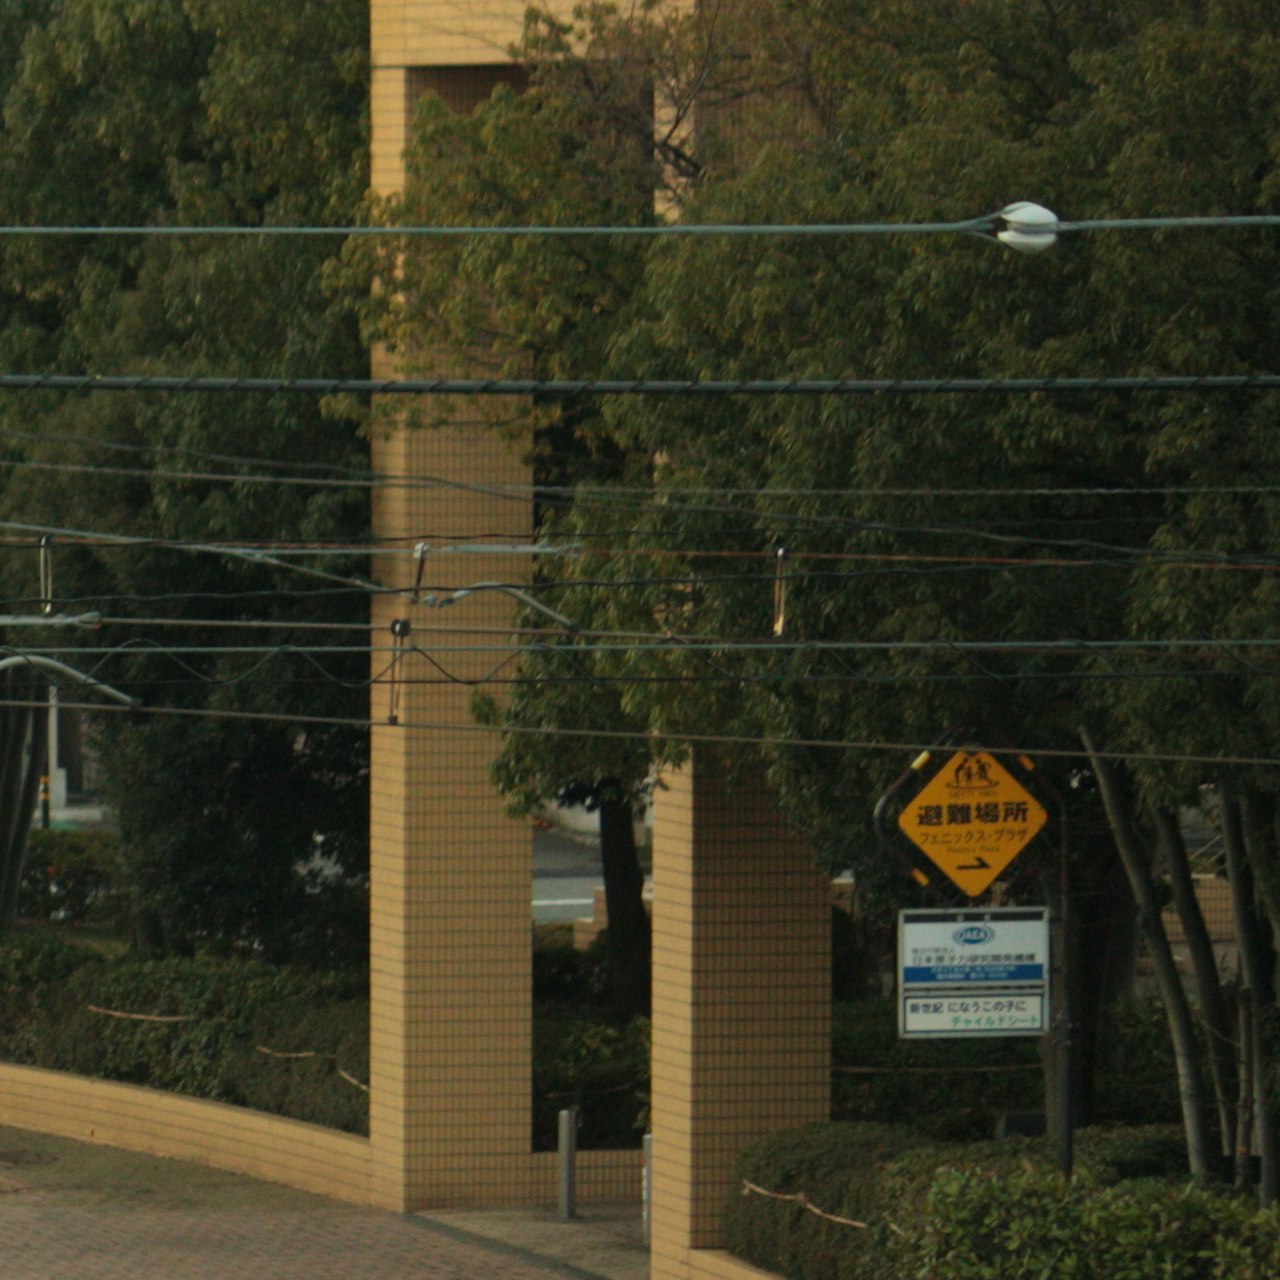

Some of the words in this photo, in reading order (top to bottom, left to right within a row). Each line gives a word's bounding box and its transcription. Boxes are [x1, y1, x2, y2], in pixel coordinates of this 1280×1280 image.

[917, 801, 1029, 826] 避難場所
[919, 827, 1029, 846] フェニックス・プラザ
[909, 1001, 943, 1014] 新世紀
[951, 1015, 1039, 1027] チャイルドシート
